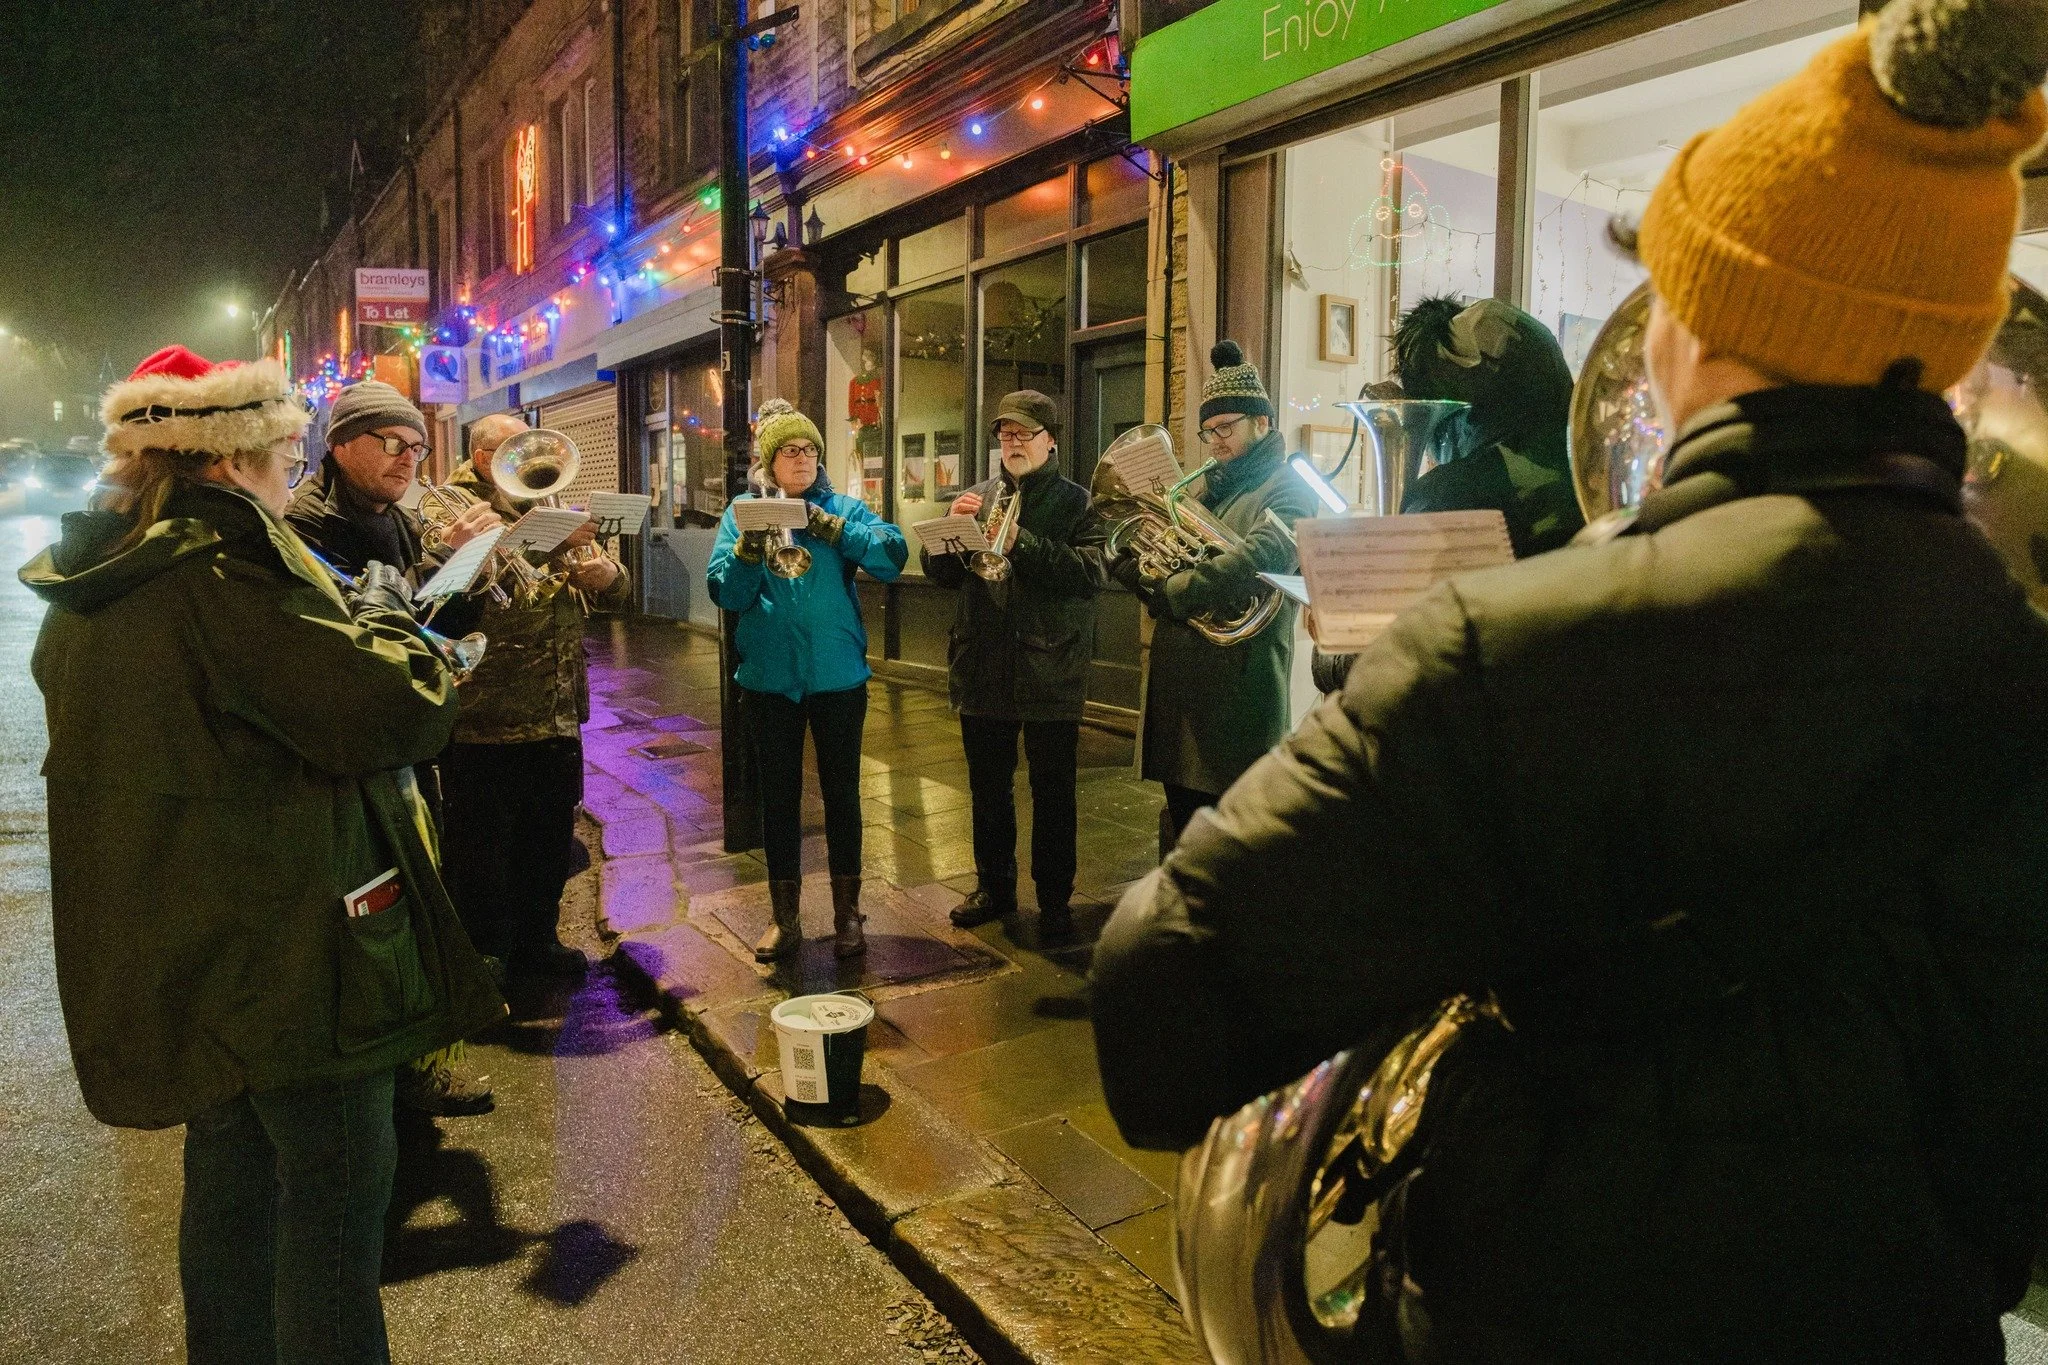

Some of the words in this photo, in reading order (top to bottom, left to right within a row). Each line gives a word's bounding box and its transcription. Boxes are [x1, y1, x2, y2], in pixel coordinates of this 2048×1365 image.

[1262, 0, 1356, 61] Enjoy
[360, 272, 426, 288] bramleys
[363, 305, 379, 319] To
[384, 306, 409, 320] Let
